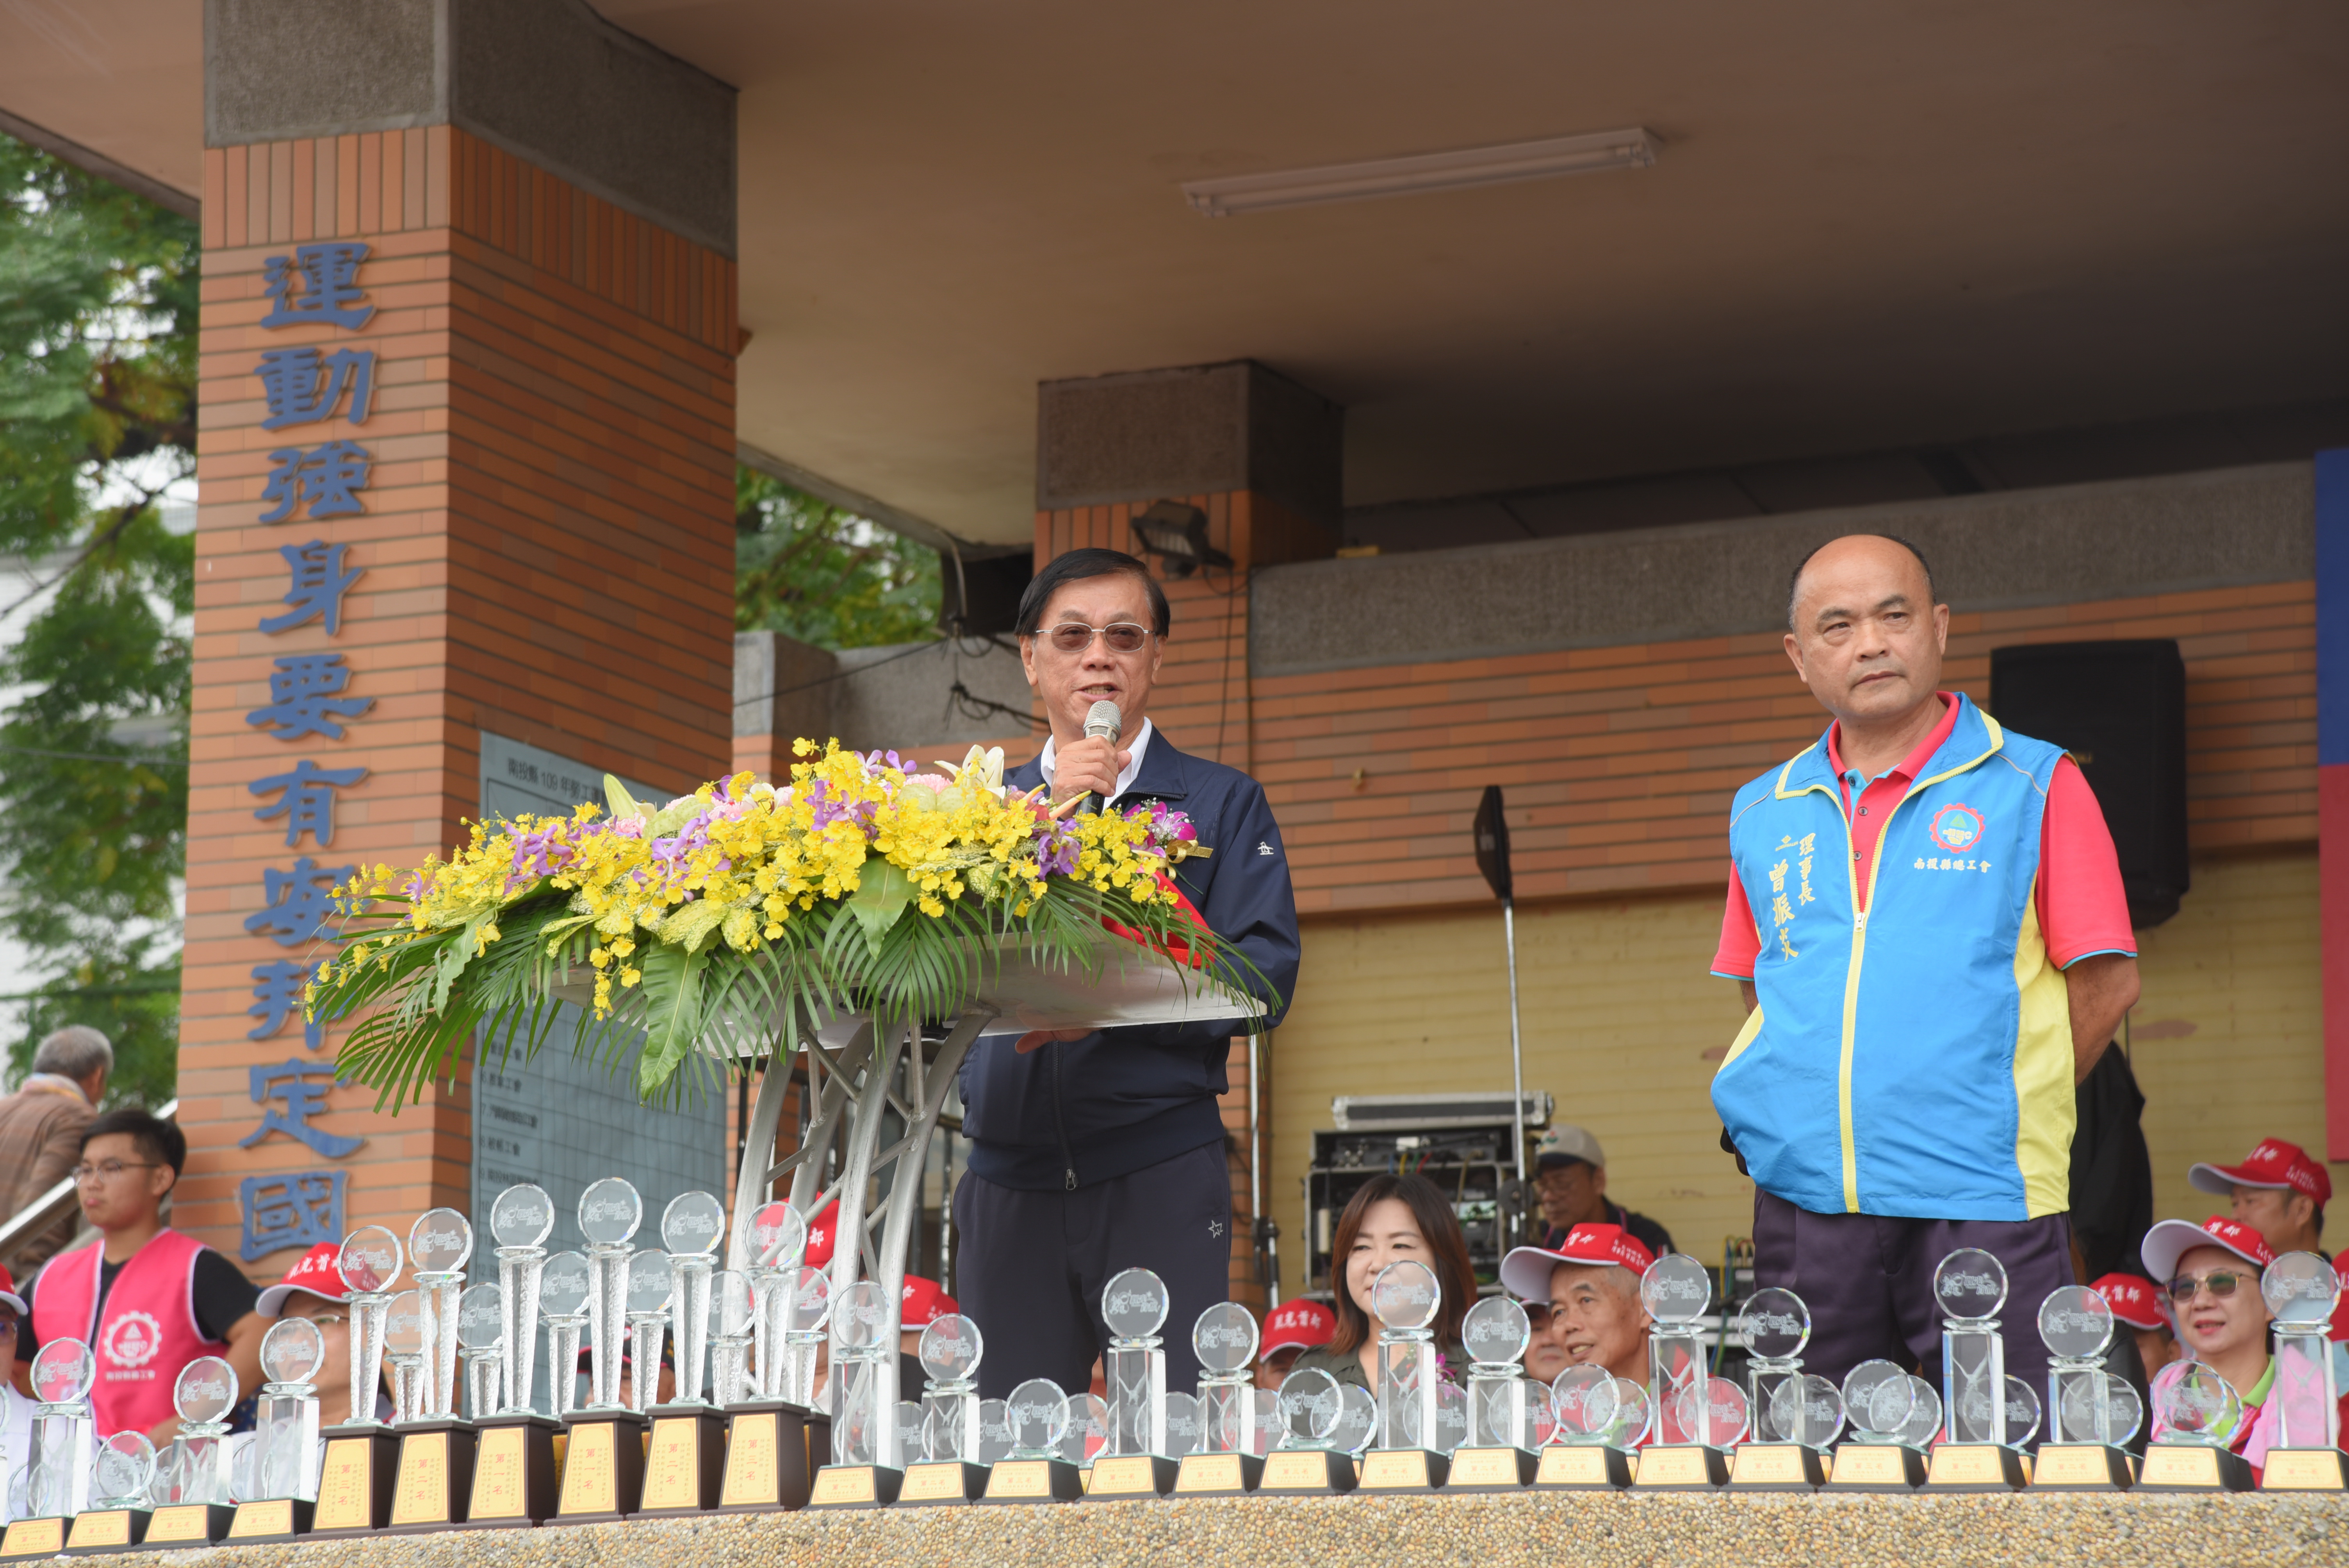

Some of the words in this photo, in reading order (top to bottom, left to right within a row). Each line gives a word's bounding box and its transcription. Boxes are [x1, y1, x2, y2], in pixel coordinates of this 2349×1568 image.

[1798, 832, 1816, 906] 理事長
[1914, 857, 1992, 873] 南投縣總工會
[1769, 859, 1798, 962] 曾振炎
[415, 1459, 428, 1500] 第二名
[492, 1454, 506, 1495] 第一名
[583, 1449, 596, 1489] 第一名
[666, 1443, 679, 1484] 第二名
[746, 1439, 758, 1480] 第三名
[338, 1465, 351, 1505] 第三名
